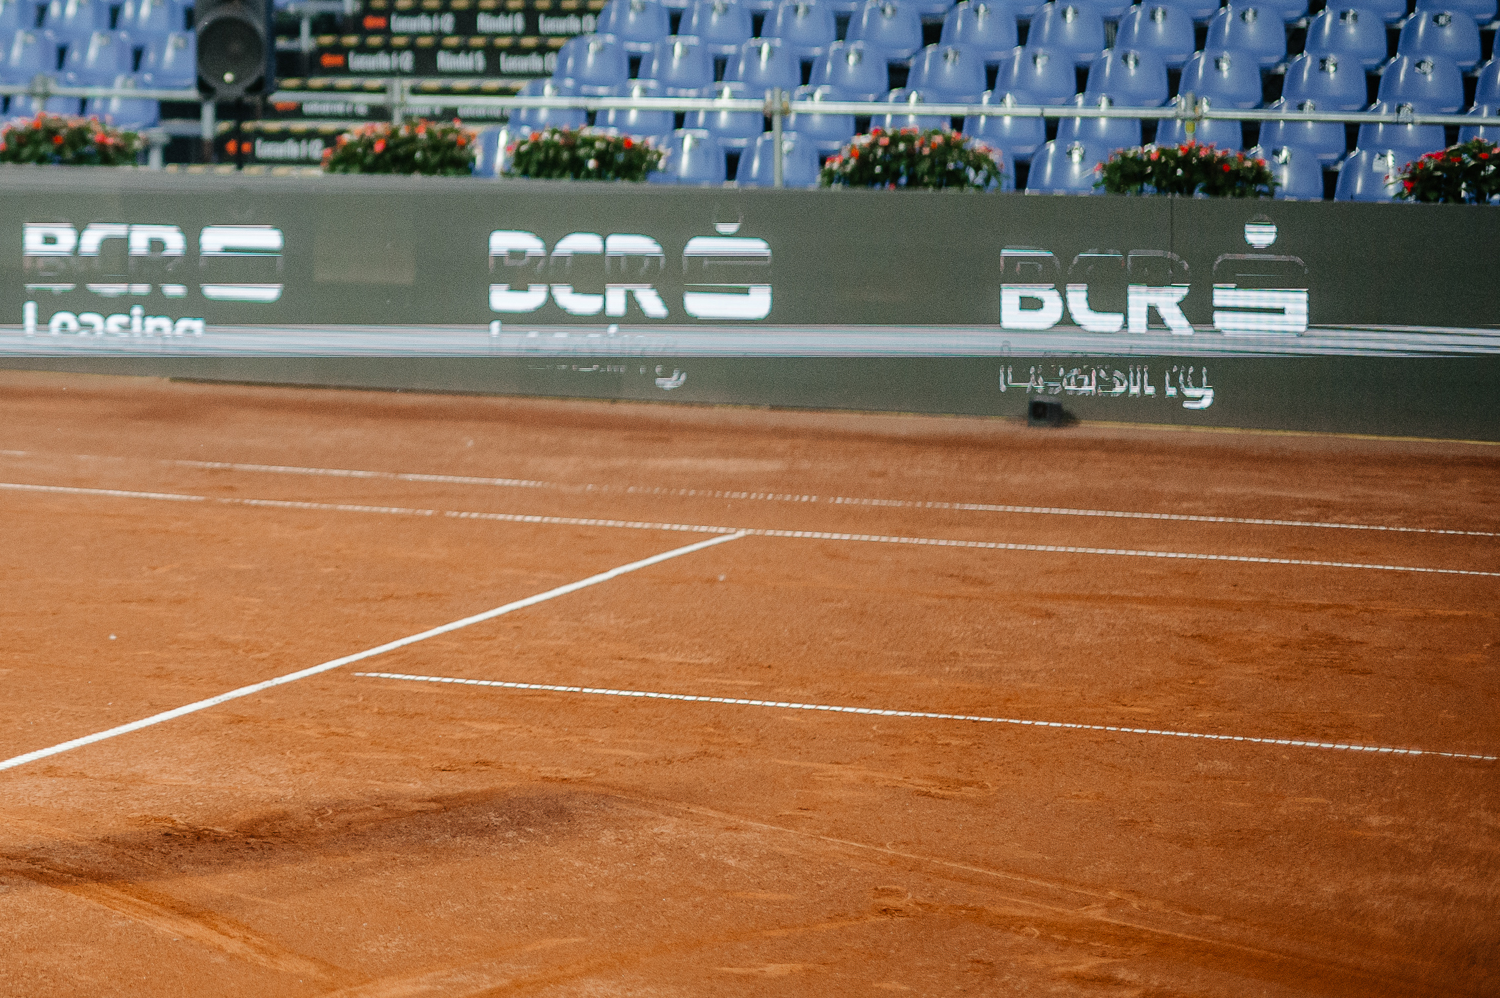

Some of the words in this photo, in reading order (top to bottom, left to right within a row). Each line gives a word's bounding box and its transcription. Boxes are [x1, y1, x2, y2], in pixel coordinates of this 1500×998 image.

[23, 222, 188, 299] BCR
[489, 229, 669, 319] BCR
[1000, 244, 1194, 336] BCR
